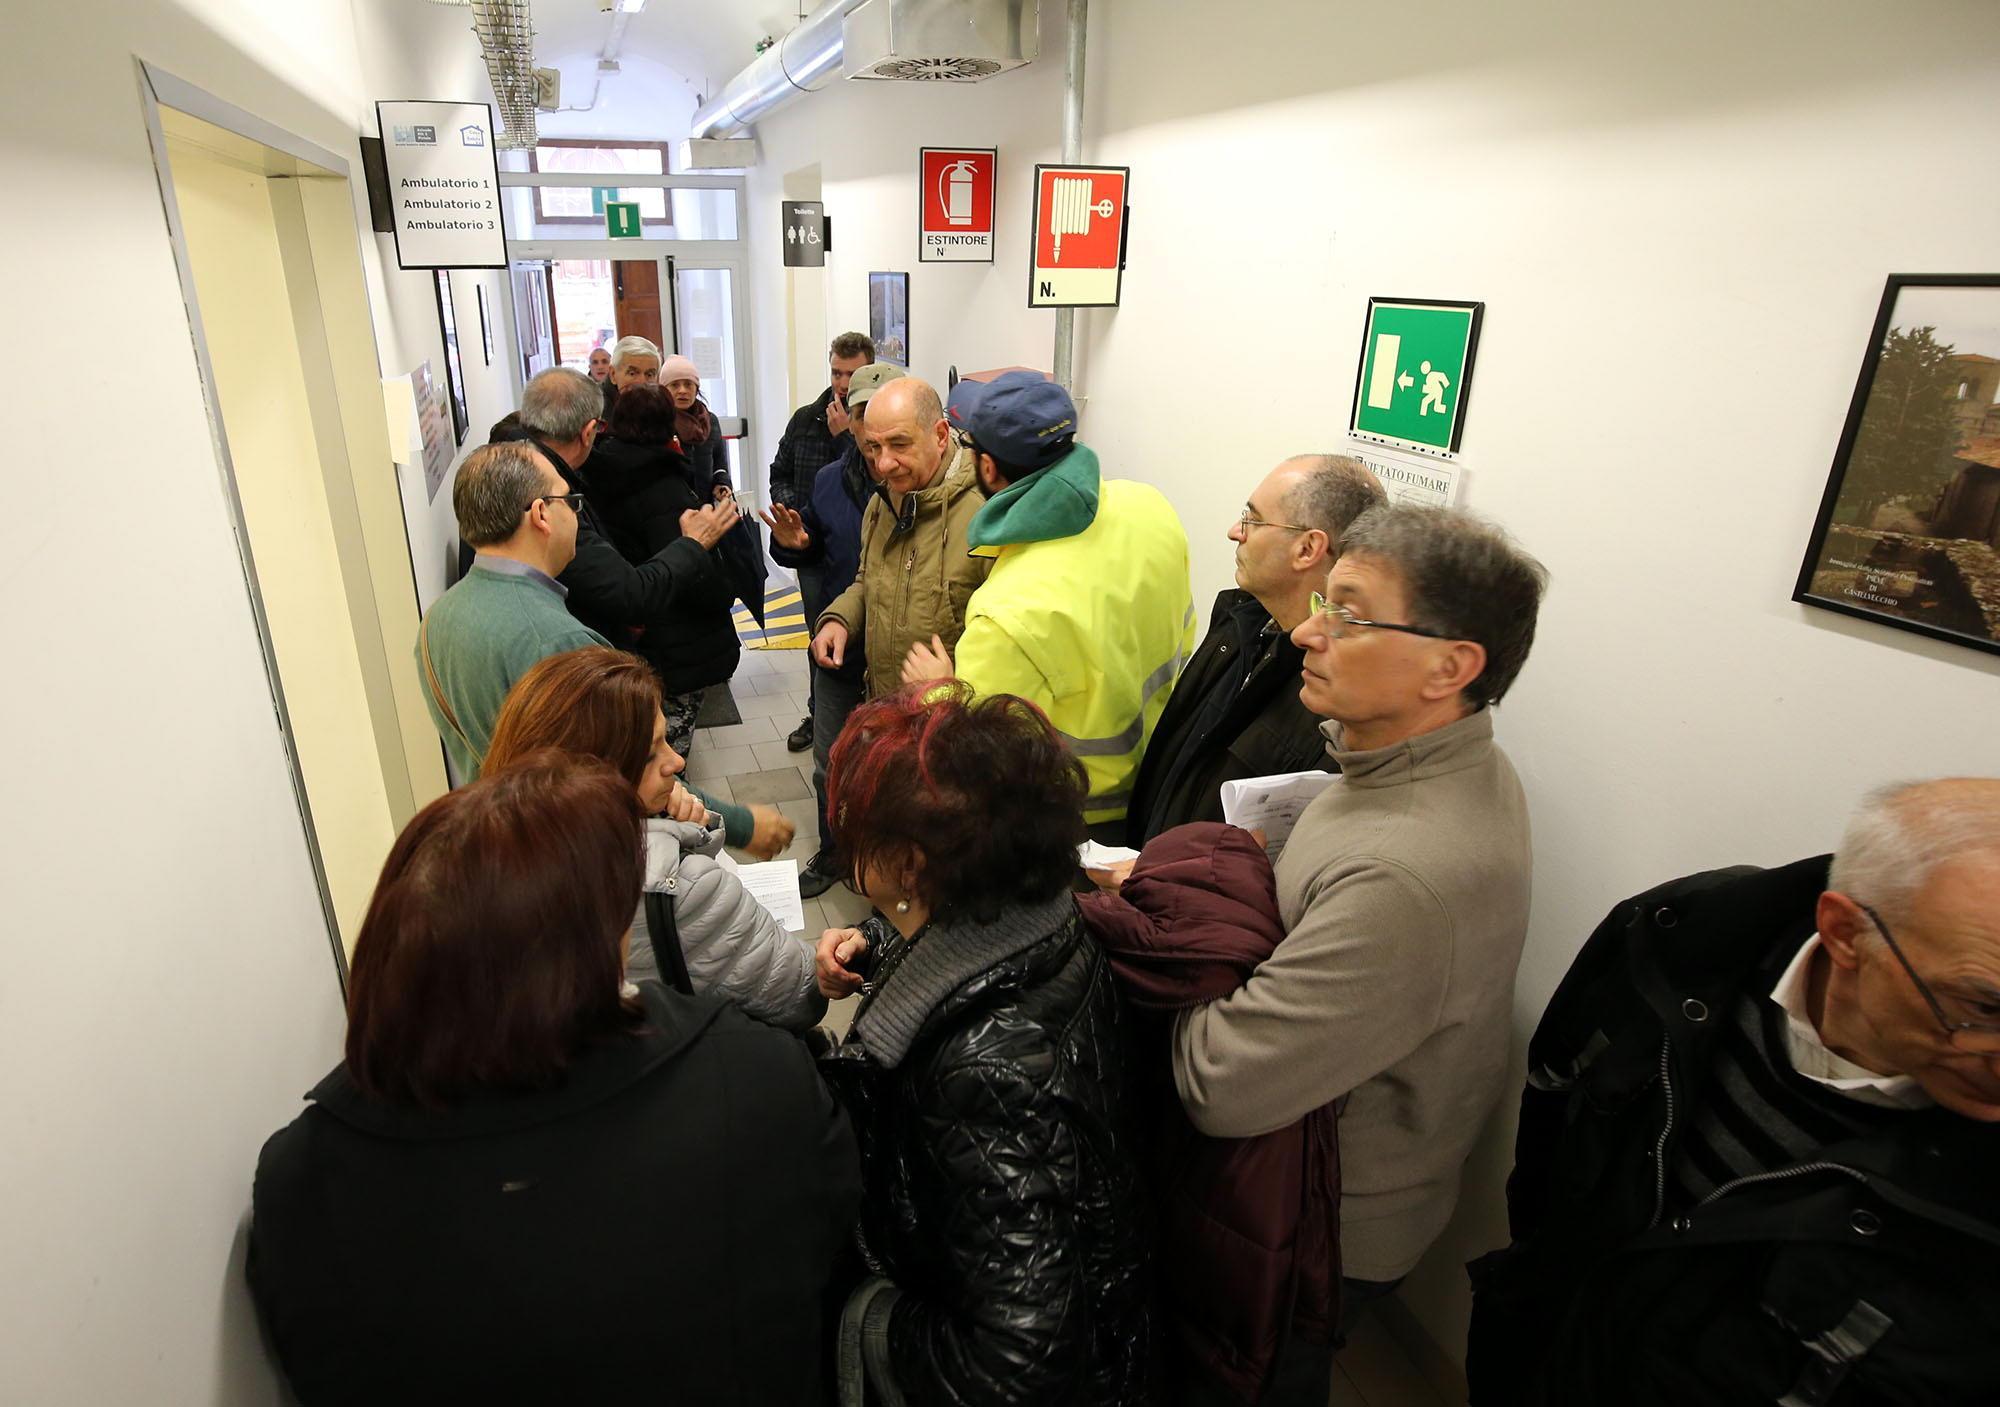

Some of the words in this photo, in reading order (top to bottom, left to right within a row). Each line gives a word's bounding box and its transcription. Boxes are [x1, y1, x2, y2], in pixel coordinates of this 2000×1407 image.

[401, 178, 478, 188] Ambulatorio
[483, 179, 489, 189] 1
[404, 199, 481, 209] Ambulatorio
[485, 200, 492, 209] 2
[407, 220, 484, 230] Ambulatorio
[487, 220, 495, 230] 3
[927, 235, 988, 245] ESTINTORE
[1040, 281, 1056, 297] N.
[1405, 472, 1450, 493] FUMARE
[1869, 584, 1878, 592] DI
